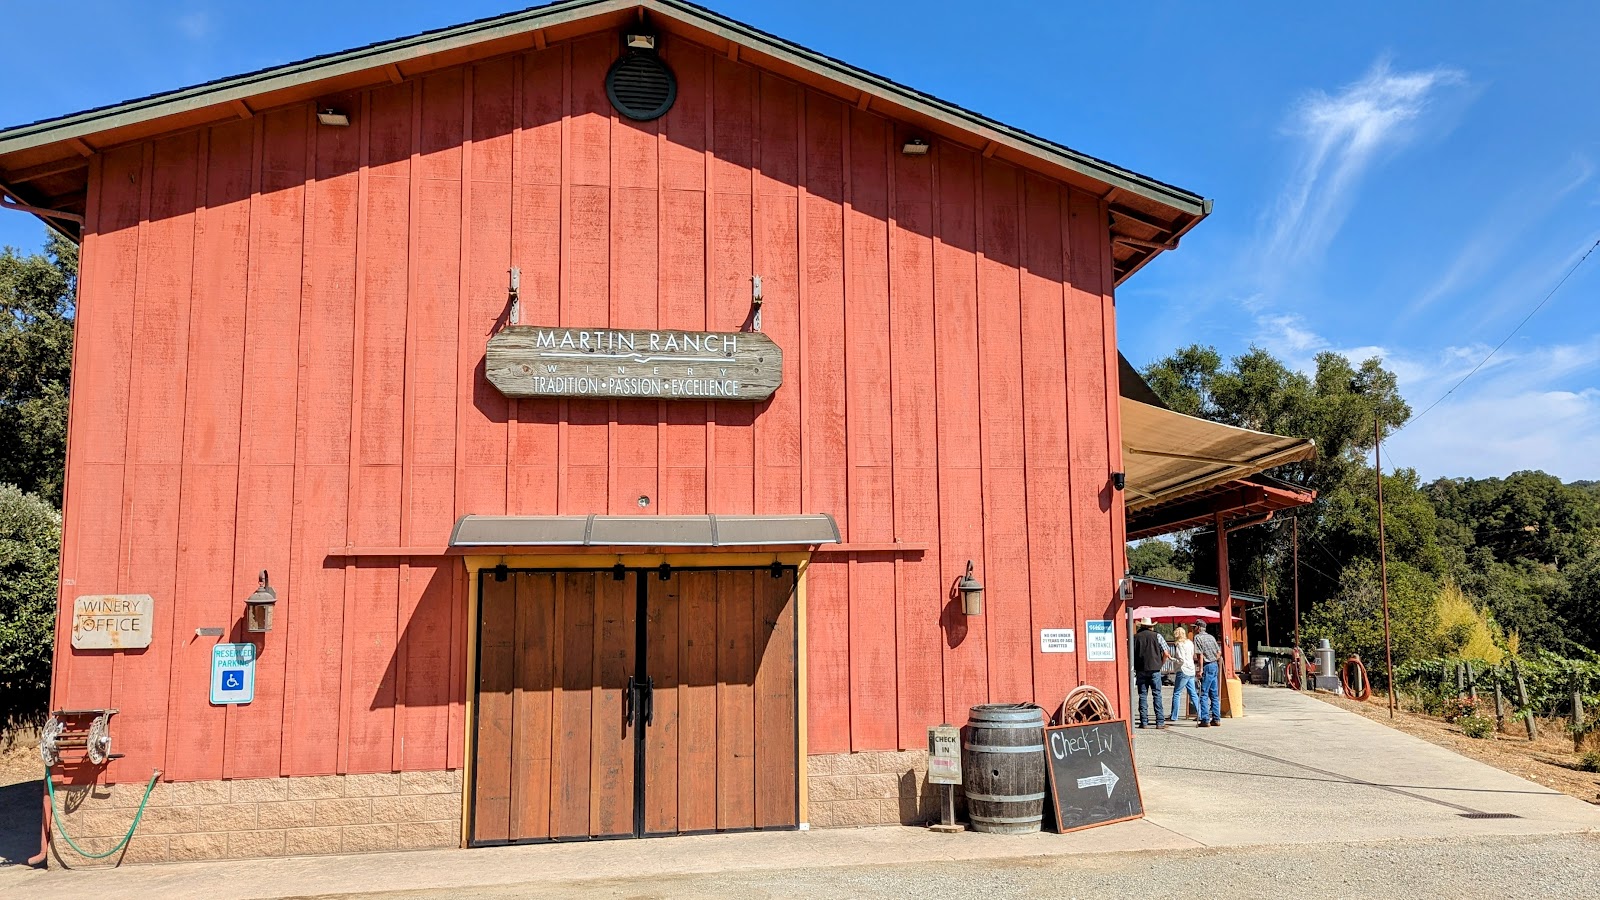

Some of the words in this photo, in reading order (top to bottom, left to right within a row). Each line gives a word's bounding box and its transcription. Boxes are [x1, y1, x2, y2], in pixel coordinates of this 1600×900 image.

[536, 330, 635, 350] MARTIN
[650, 332, 737, 353] RANCH
[547, 364, 727, 376] WINERY
[533, 377, 598, 394] TRADITION
[609, 378, 661, 395] PASSION
[671, 379, 739, 396] EXCELLENCE
[83, 600, 140, 613] WINERY
[83, 618, 140, 632] OFFICE
[215, 649, 252, 658] RESERVED
[217, 659, 249, 668] PARKING
